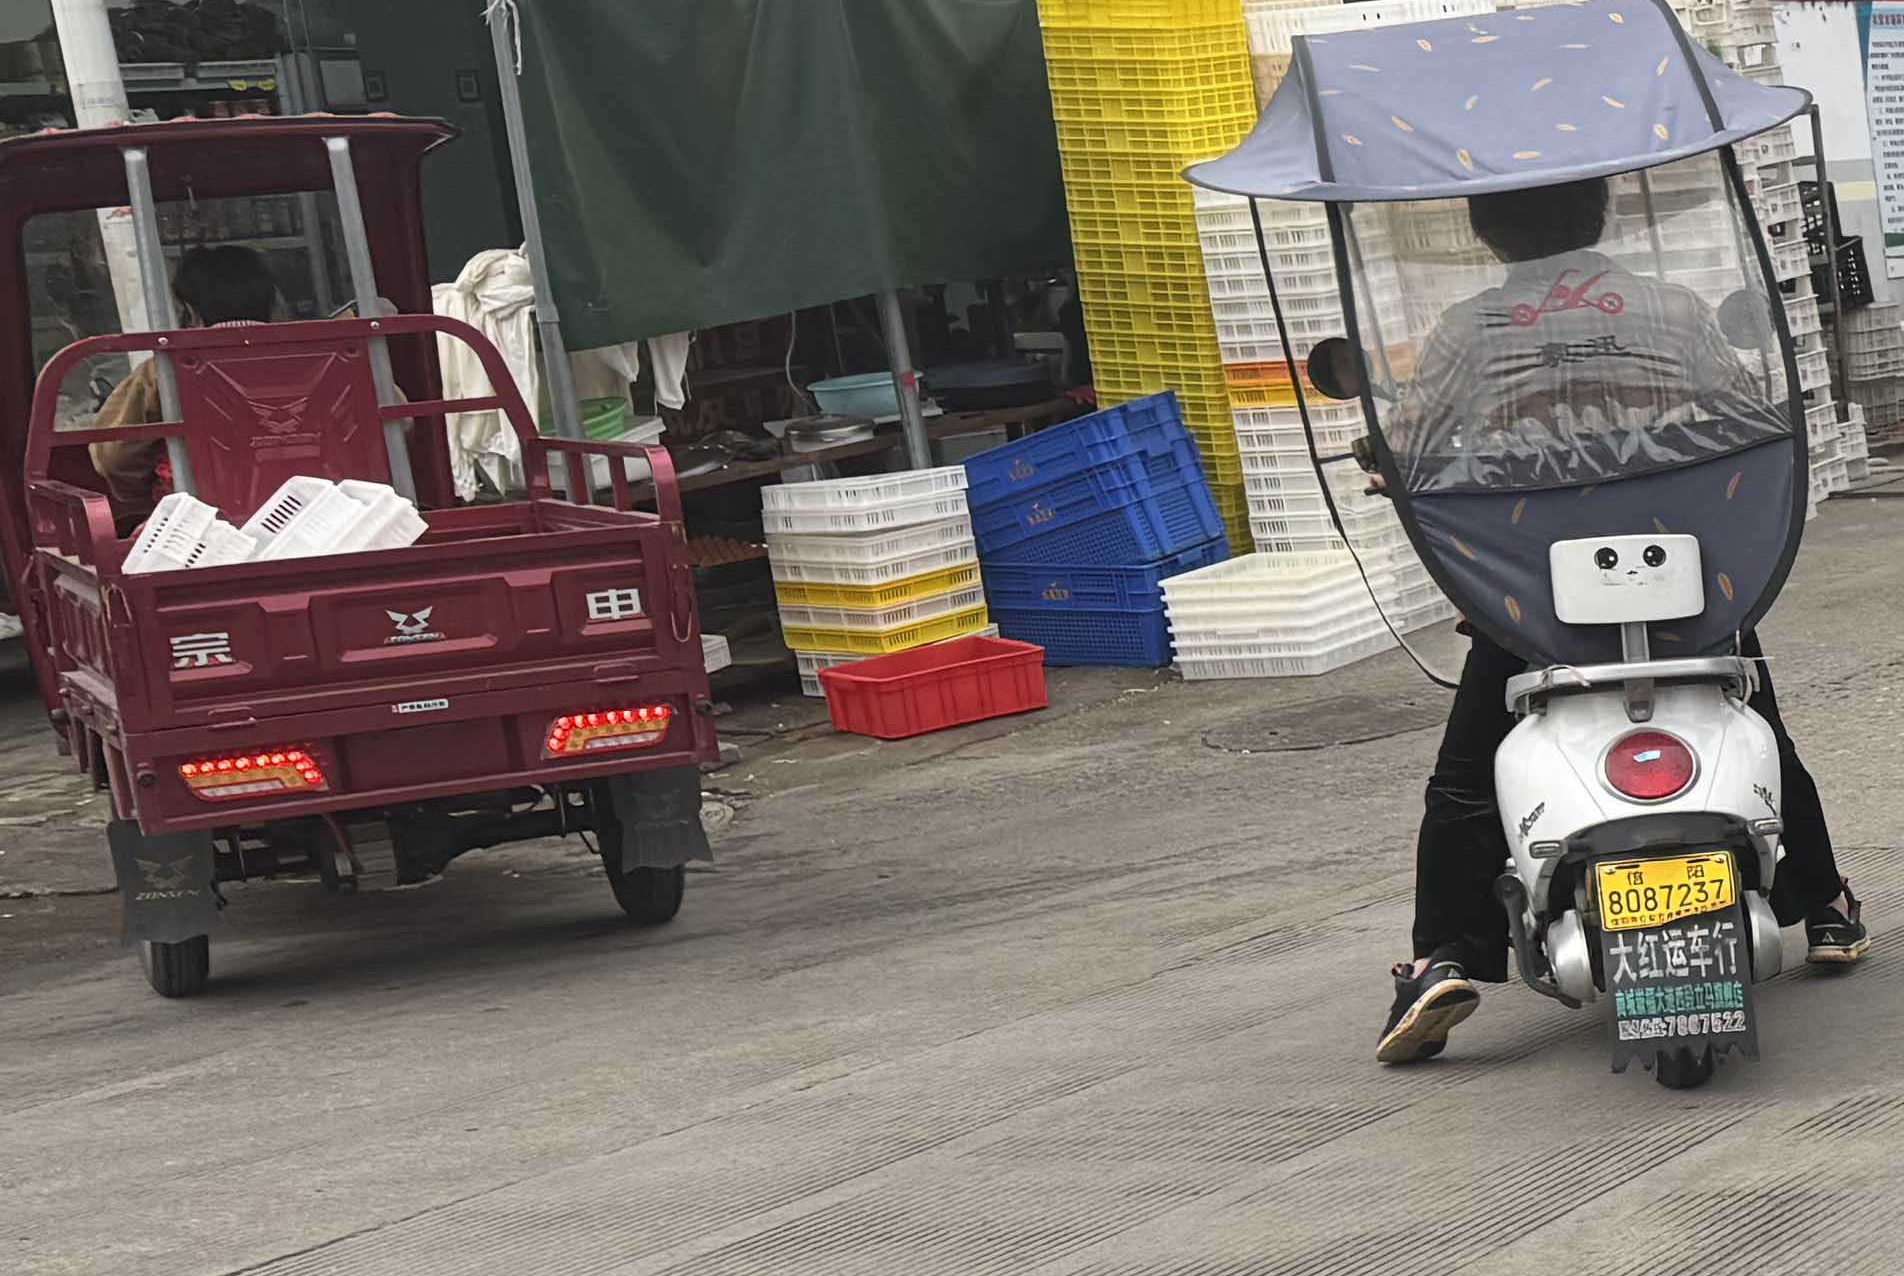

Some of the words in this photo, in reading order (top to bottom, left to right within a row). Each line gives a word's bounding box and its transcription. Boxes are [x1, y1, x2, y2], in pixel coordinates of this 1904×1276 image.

[169, 631, 234, 669] 宗
[585, 588, 642, 621] 申
[1608, 878, 1725, 916] 8087237
[1627, 870, 1644, 886] 信
[1687, 864, 1705, 880] 阳
[1610, 921, 1738, 984] 大红运车行
